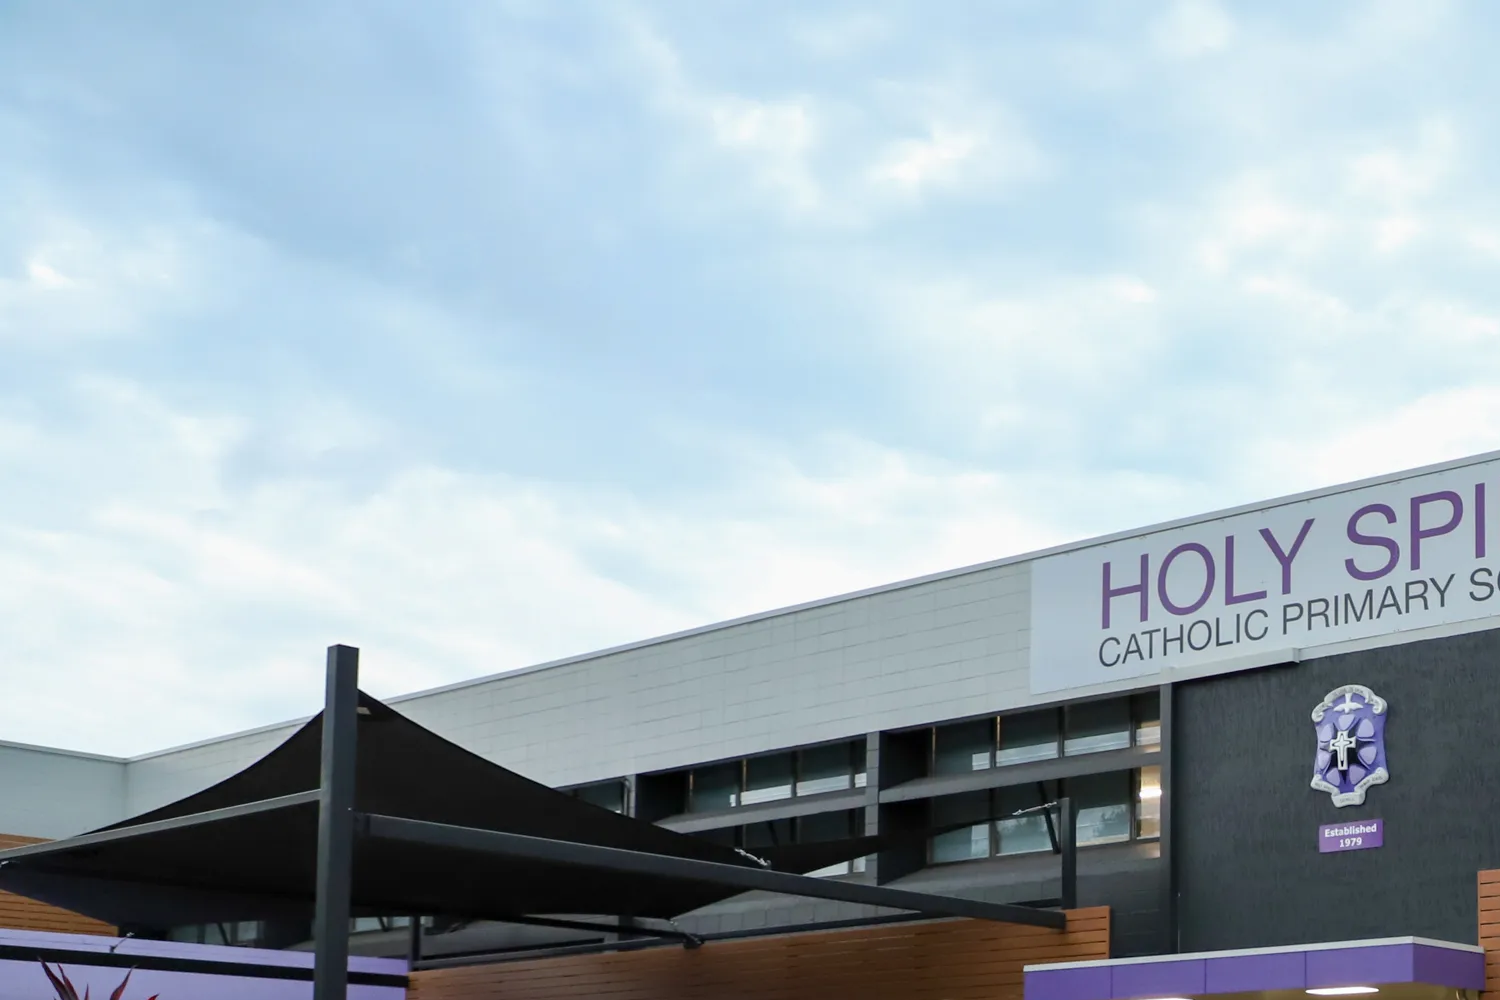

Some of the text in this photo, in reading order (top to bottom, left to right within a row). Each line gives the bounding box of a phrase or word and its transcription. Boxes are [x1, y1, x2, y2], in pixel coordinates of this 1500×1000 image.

[1101, 517, 1316, 630] HOLY
[1098, 608, 1269, 668] CATHOLIC
[1282, 573, 1456, 636] PRIMARY
[1324, 823, 1377, 838] Established
[1339, 836, 1363, 848] 1979
